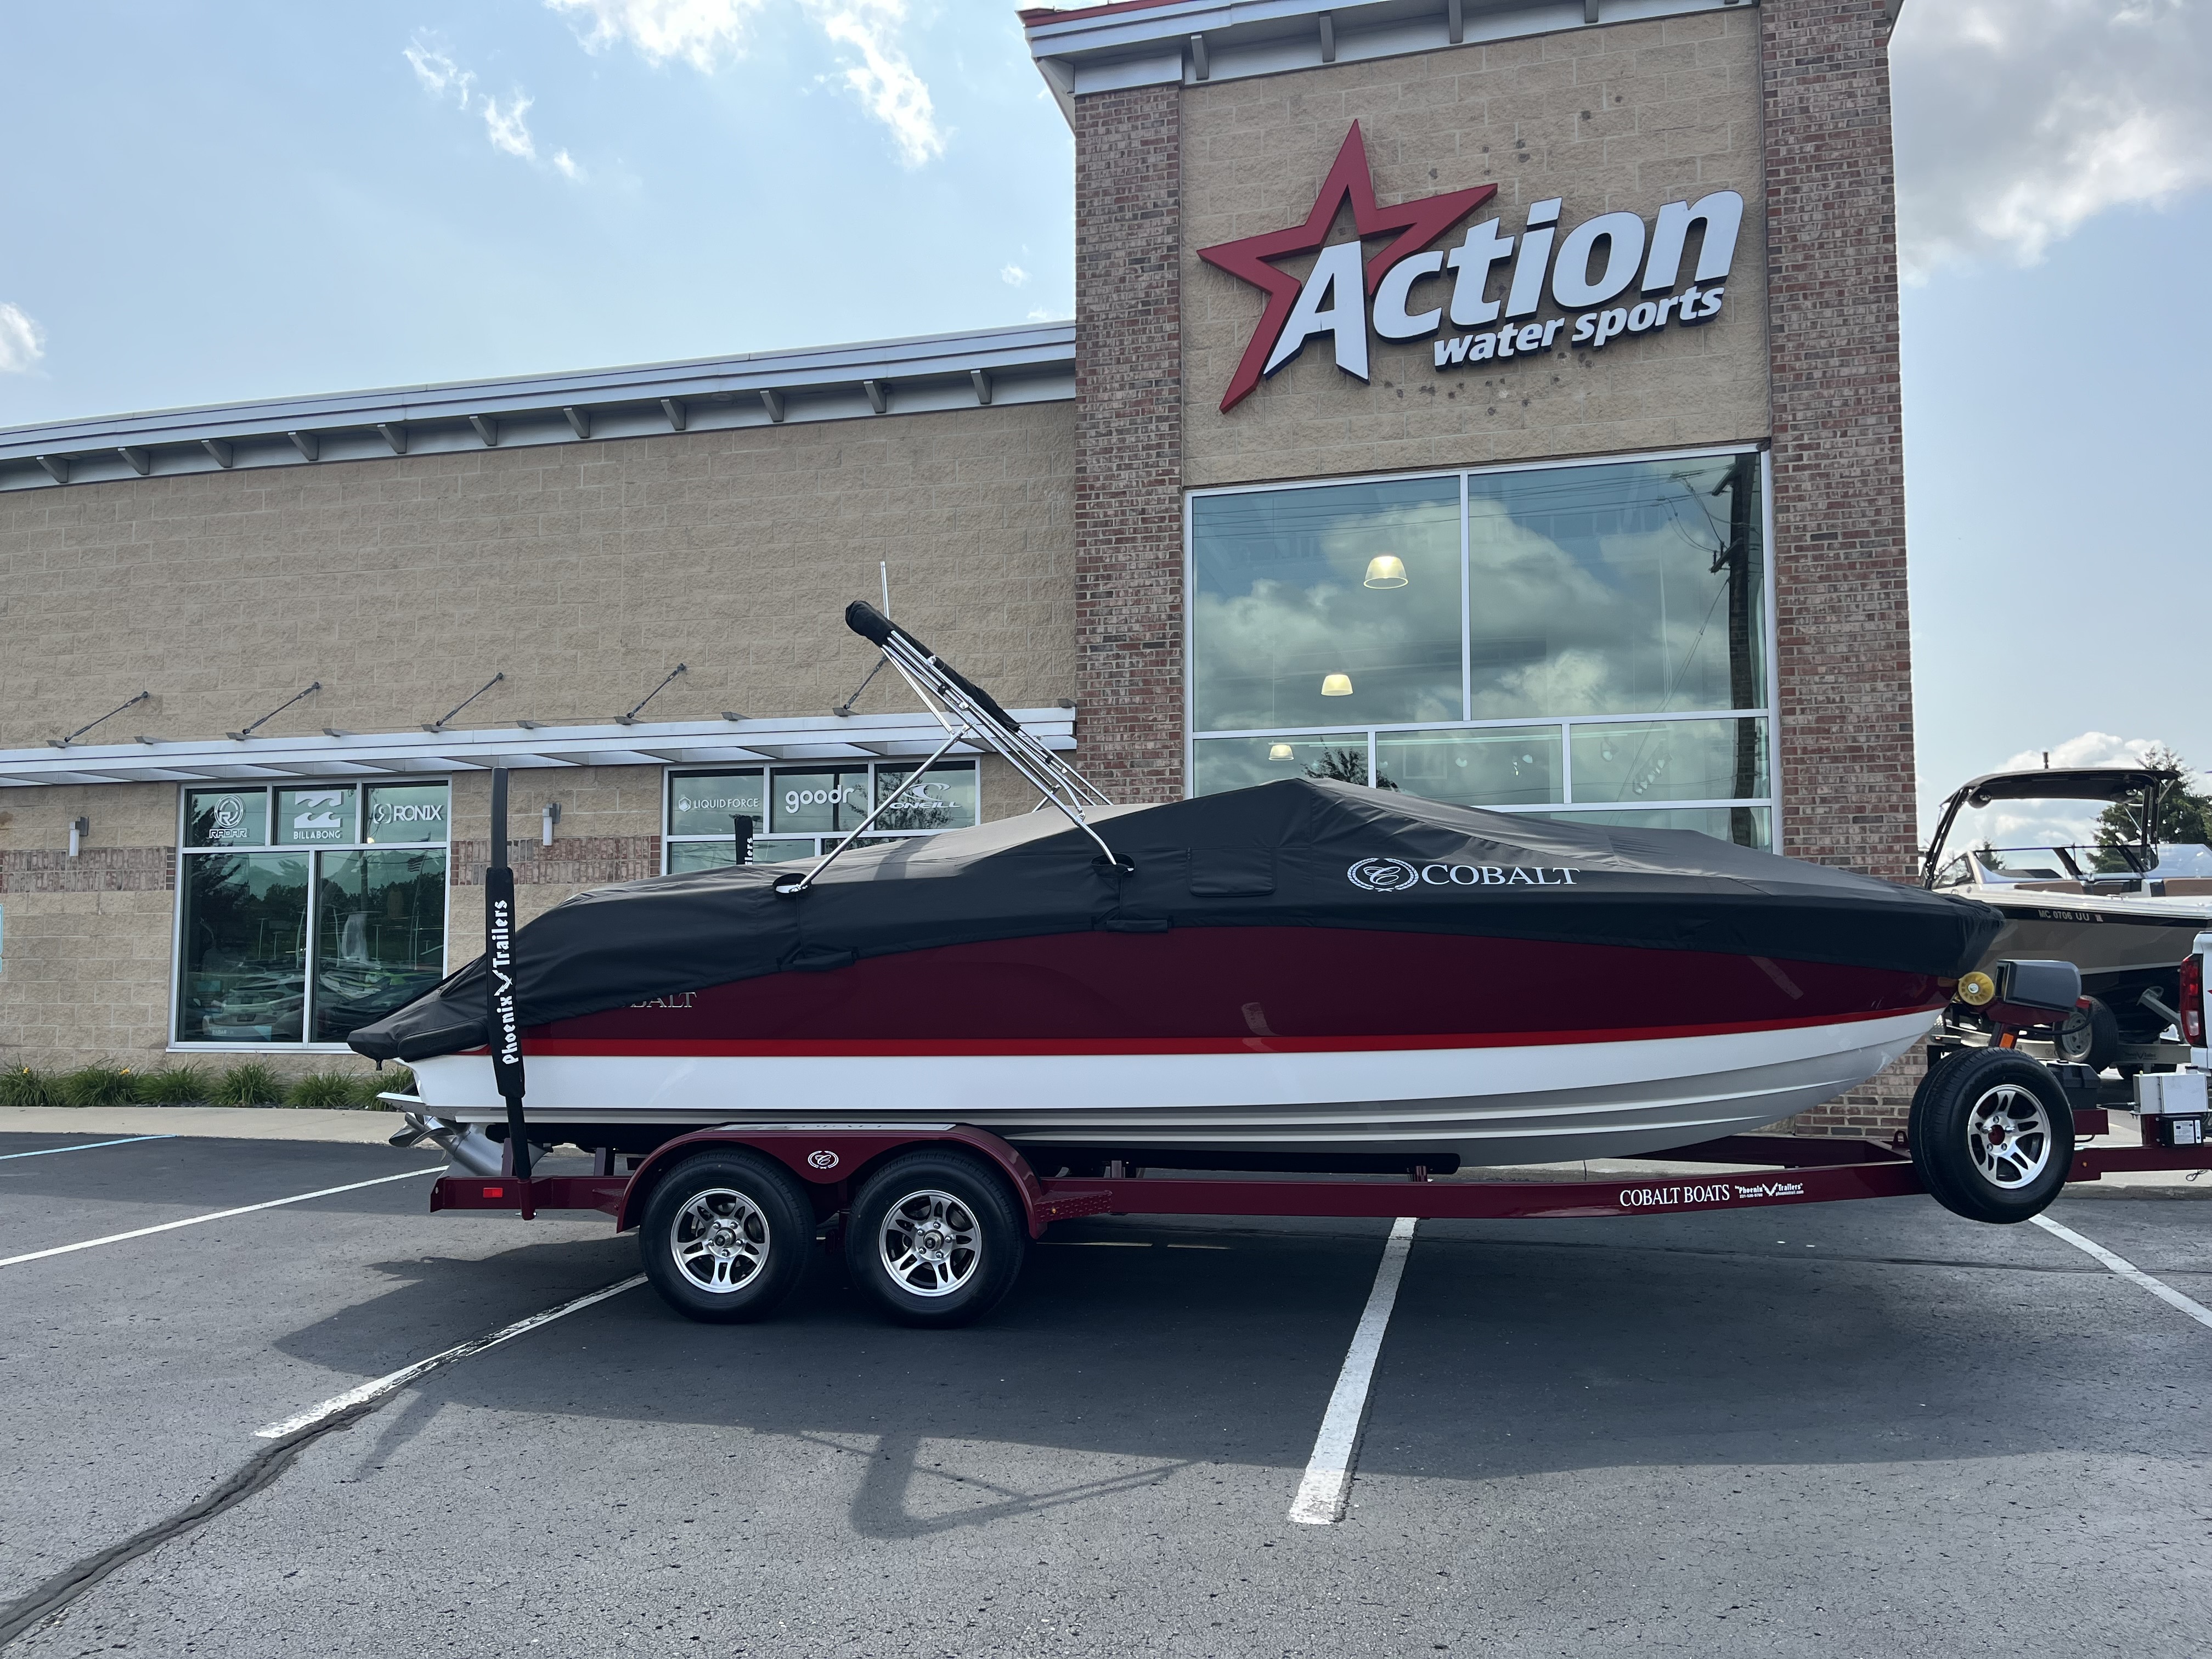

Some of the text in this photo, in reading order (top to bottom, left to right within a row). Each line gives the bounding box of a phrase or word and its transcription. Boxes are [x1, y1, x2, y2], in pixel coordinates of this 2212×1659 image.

[1263, 190, 1745, 383] Action
[1434, 285, 1725, 369] water sports
[693, 798, 759, 809] LIQUID FORCE
[785, 785, 855, 813] goodr
[393, 804, 443, 821] RONIX
[209, 828, 247, 839] RADAR
[293, 830, 341, 839] BILLABONG
[1421, 864, 1581, 885] COBALT
[2038, 909, 2051, 918] MC
[2053, 911, 2073, 920] 0706
[2075, 912, 2090, 921] UU
[491, 900, 519, 1065] Phoenix Trailers
[1620, 1184, 1730, 1207] COBALT BOATS
[1739, 1185, 1763, 1194] Phoenix
[1778, 1183, 1802, 1192] Trailers
